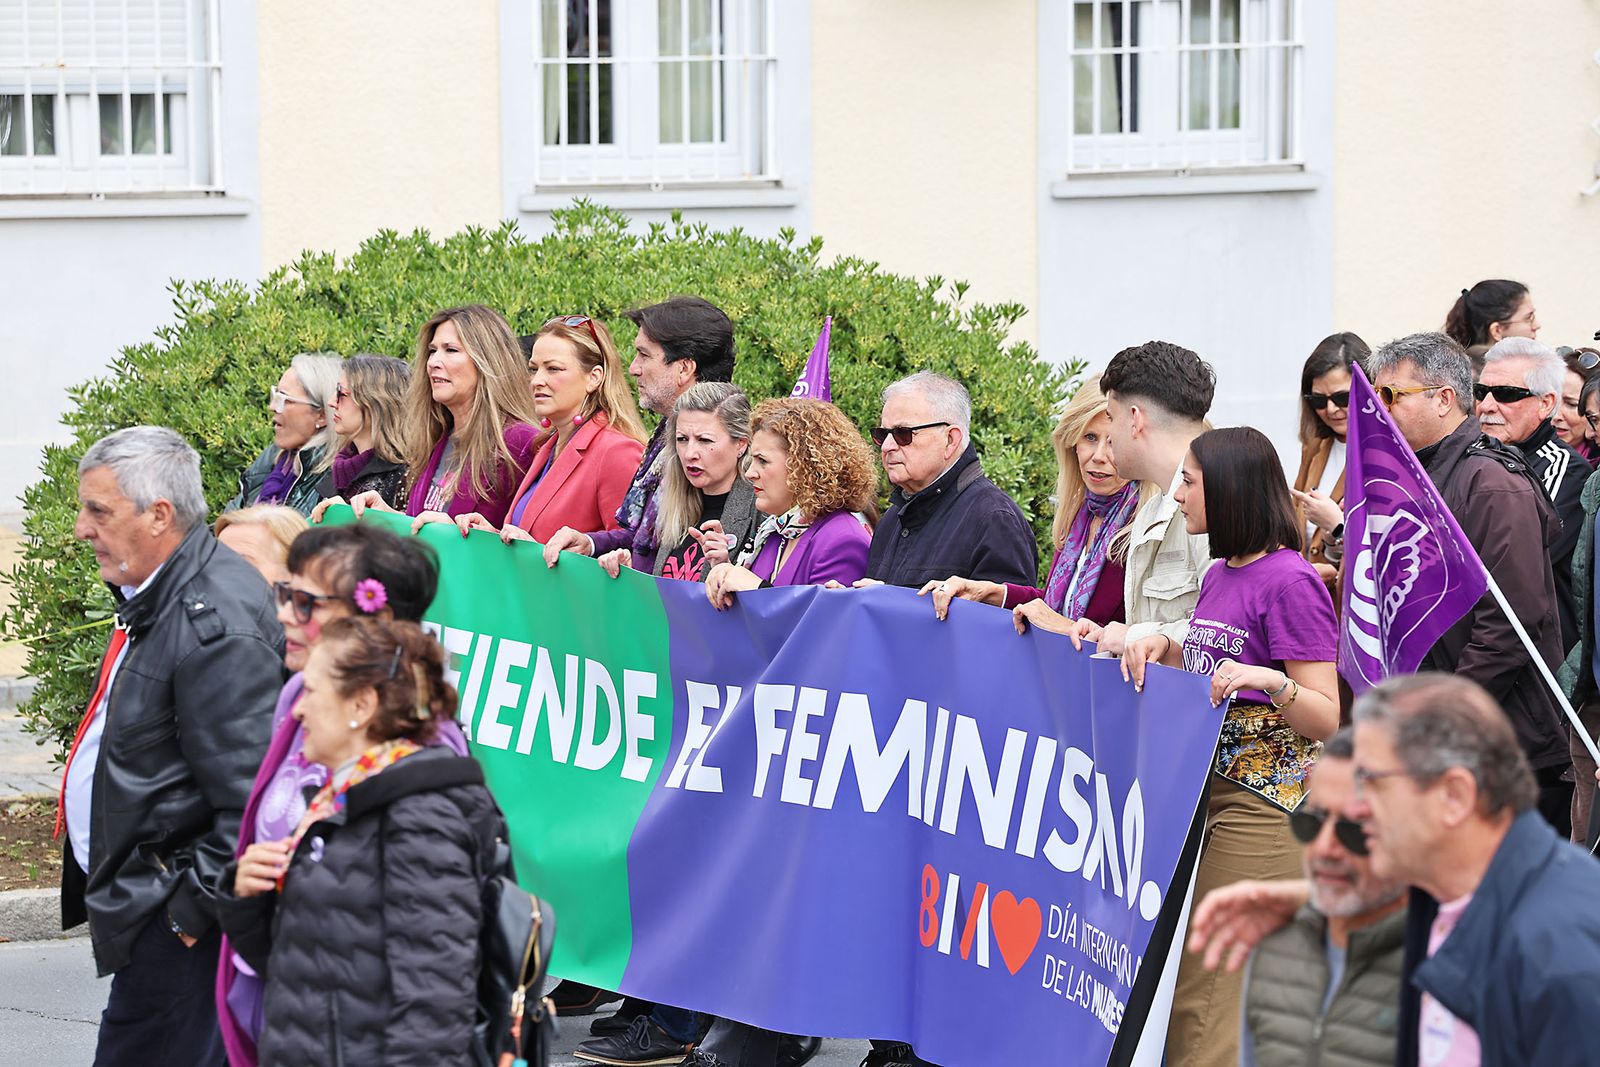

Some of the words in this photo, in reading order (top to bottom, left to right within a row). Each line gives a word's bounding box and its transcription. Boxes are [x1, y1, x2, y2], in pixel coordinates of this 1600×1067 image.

[421, 620, 658, 783] FIENDE
[665, 680, 742, 793] EL
[753, 683, 1162, 922] FEMINISMO.
[1047, 902, 1077, 948] DÍA
[1042, 954, 1067, 995] DE
[1065, 965, 1092, 1009] LAS
